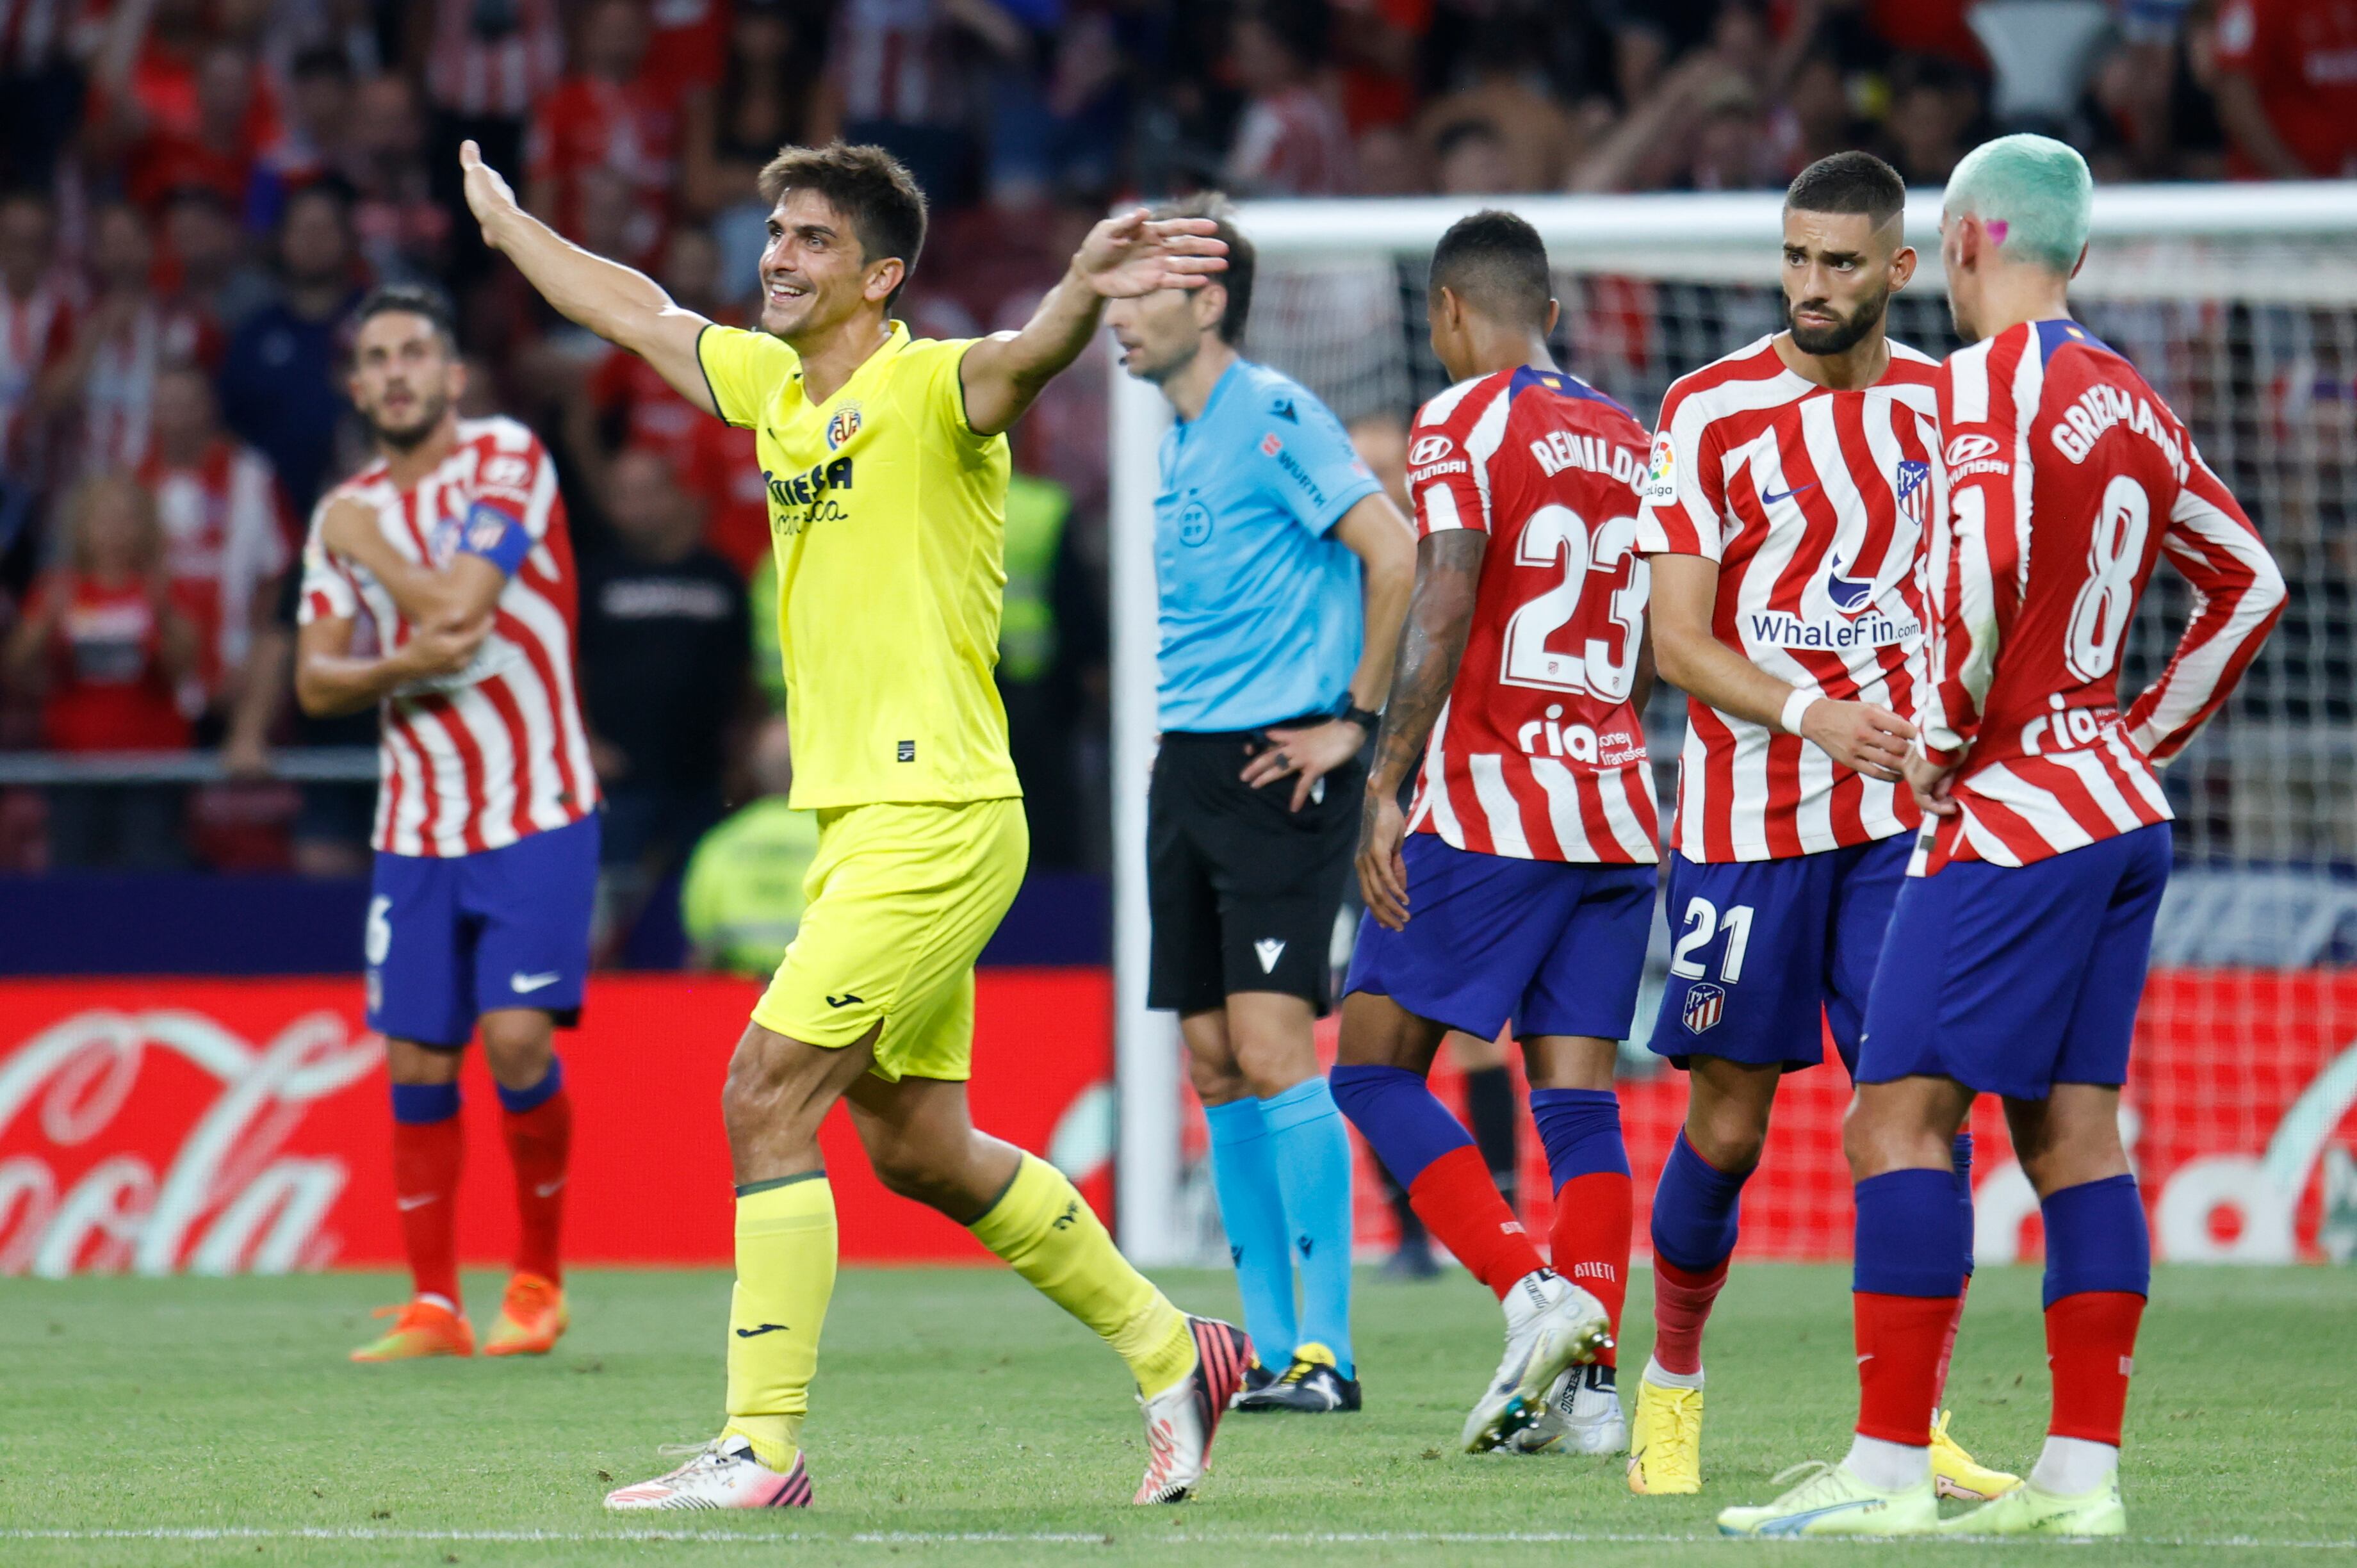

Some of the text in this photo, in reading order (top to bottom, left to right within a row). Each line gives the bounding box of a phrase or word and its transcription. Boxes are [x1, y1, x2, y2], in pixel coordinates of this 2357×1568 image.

[1499, 504, 1651, 705] 23
[2064, 474, 2149, 684] 8
[1518, 704, 1598, 764] ria
[1670, 897, 1754, 984] 21
[1574, 1261, 1615, 1283] ATLETI
